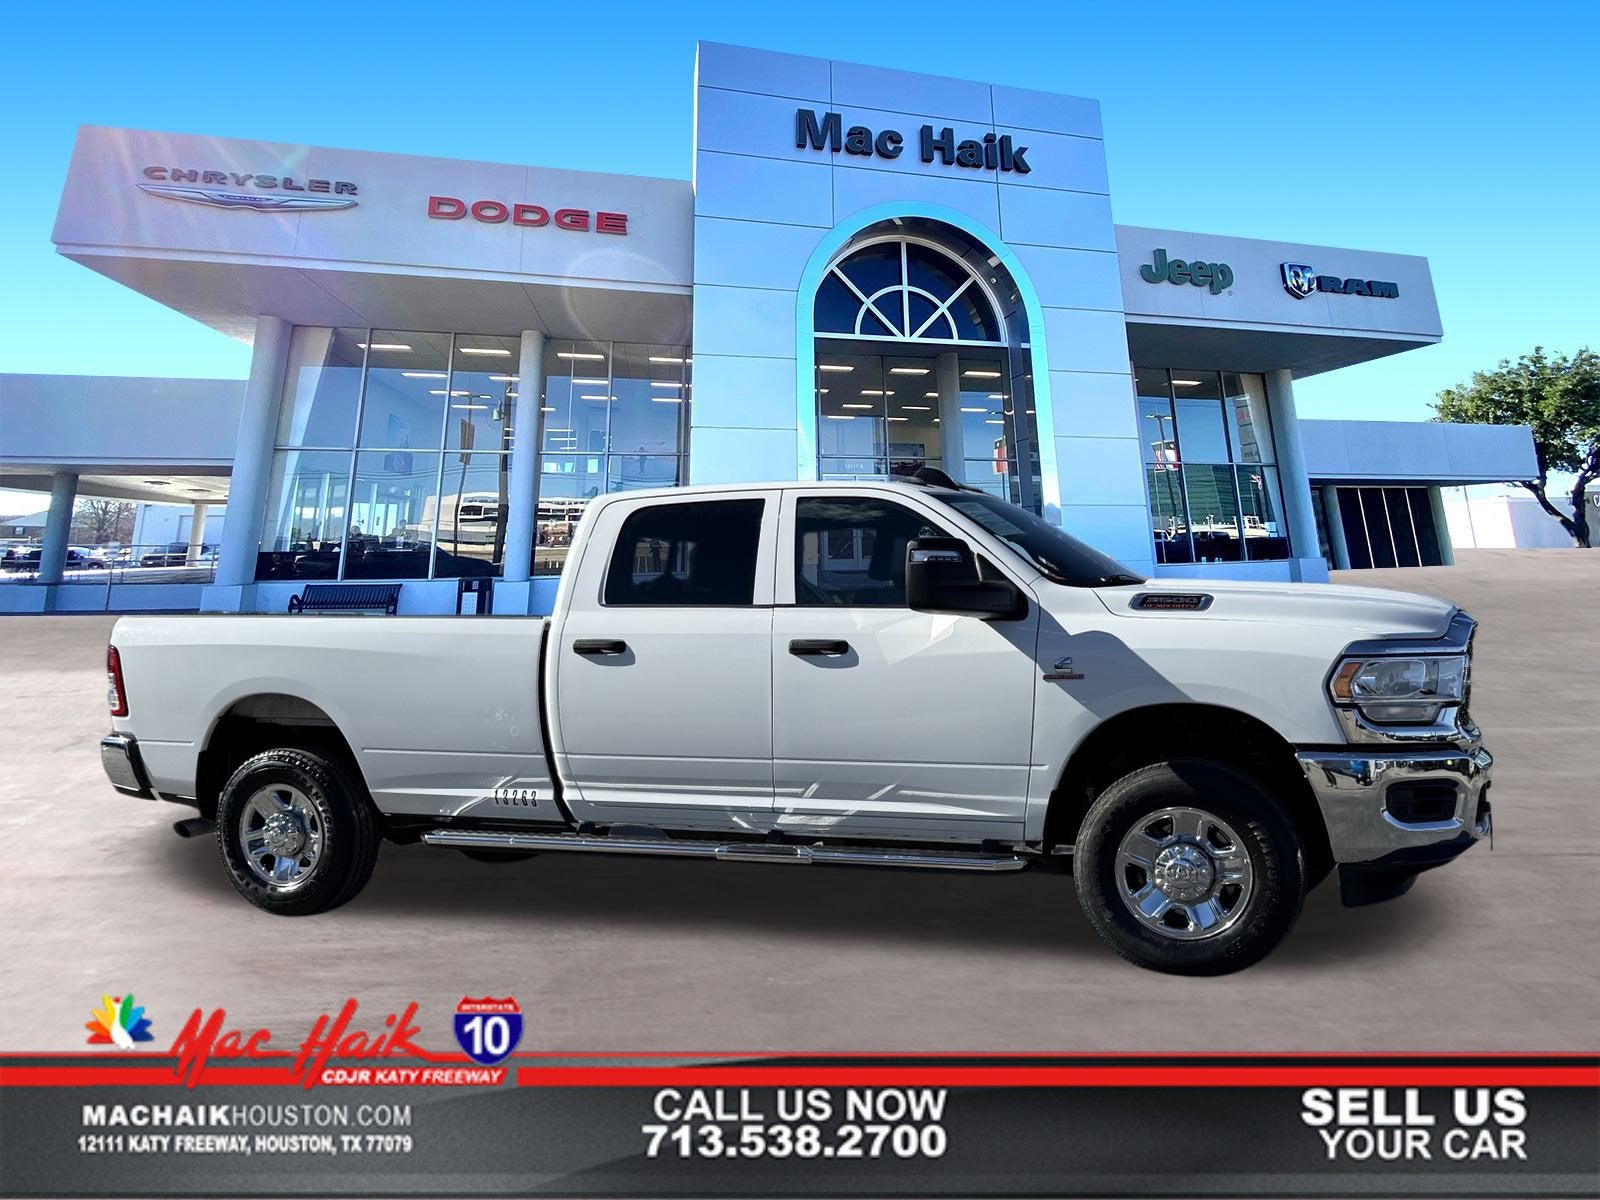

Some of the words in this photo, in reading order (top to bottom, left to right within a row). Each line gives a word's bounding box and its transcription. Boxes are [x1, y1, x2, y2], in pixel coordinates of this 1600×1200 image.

[796, 108, 904, 160] Mac
[919, 124, 1032, 174] Haik
[143, 166, 358, 195] CHRYSLER
[428, 196, 628, 236] DODGE
[1140, 248, 1234, 296] Jeep
[1316, 275, 1400, 299] RAM
[494, 788, 537, 807] 13263
